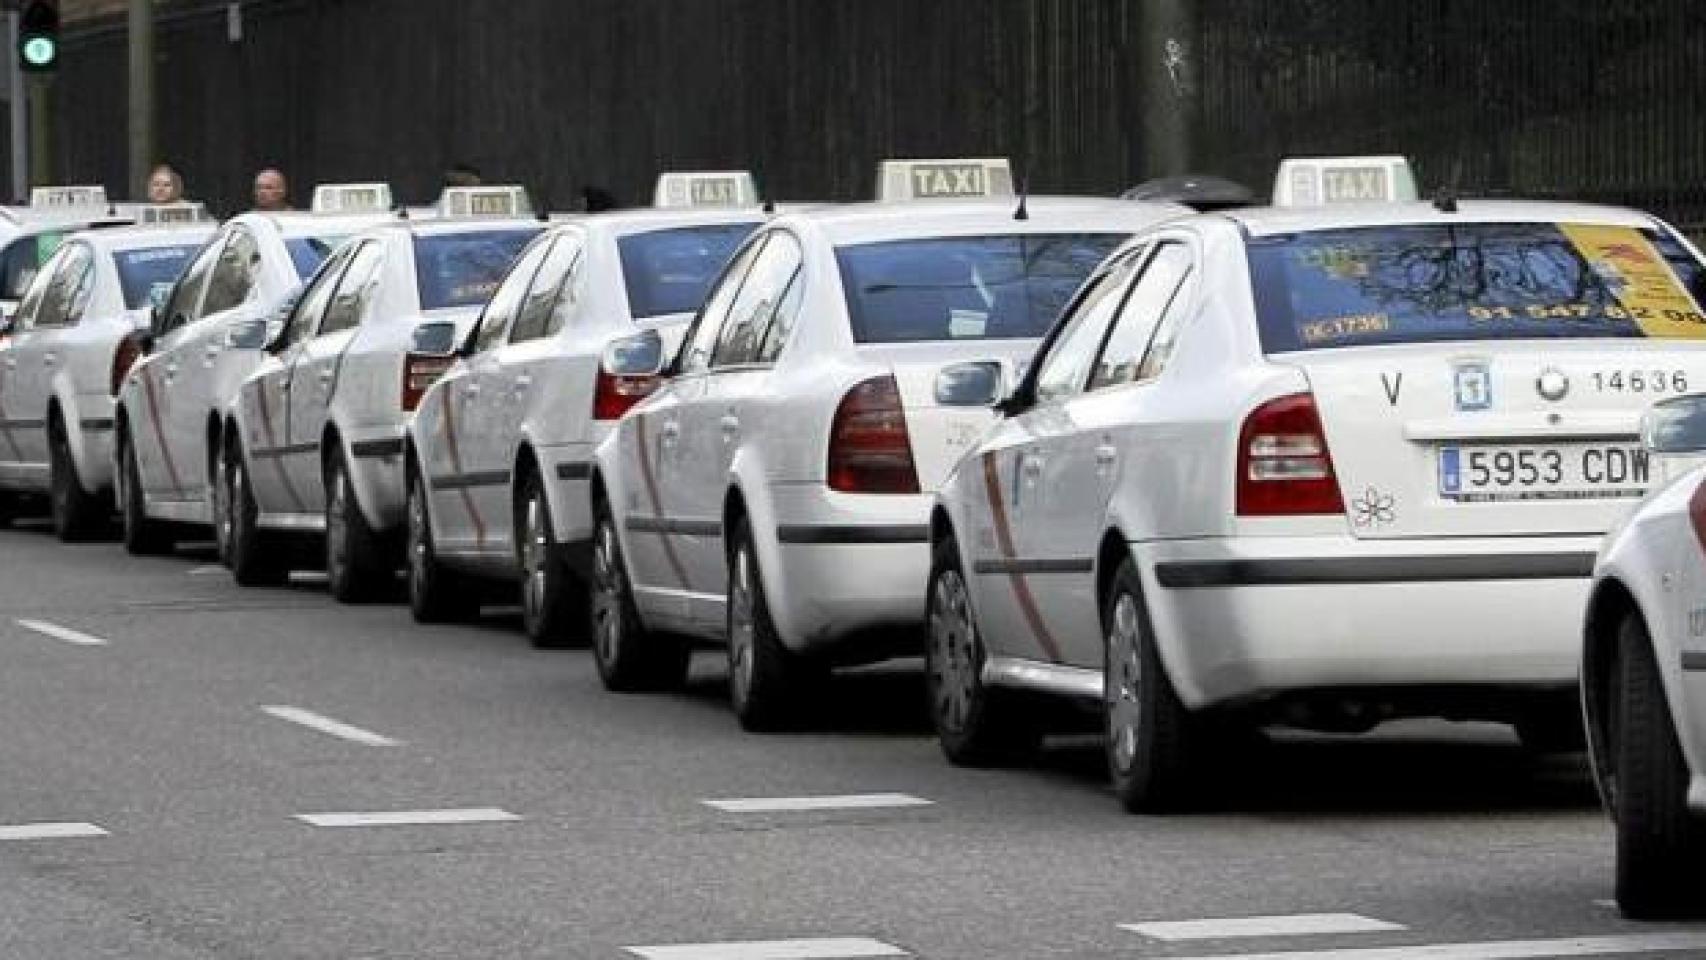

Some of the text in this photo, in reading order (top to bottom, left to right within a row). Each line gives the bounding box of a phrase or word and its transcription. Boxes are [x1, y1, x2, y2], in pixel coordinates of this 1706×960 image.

[913, 168, 982, 193] TAXI
[1325, 170, 1386, 199] TAXI
[1381, 370, 1688, 406] V 14636
[1469, 447, 1650, 485] 5953 CDW
